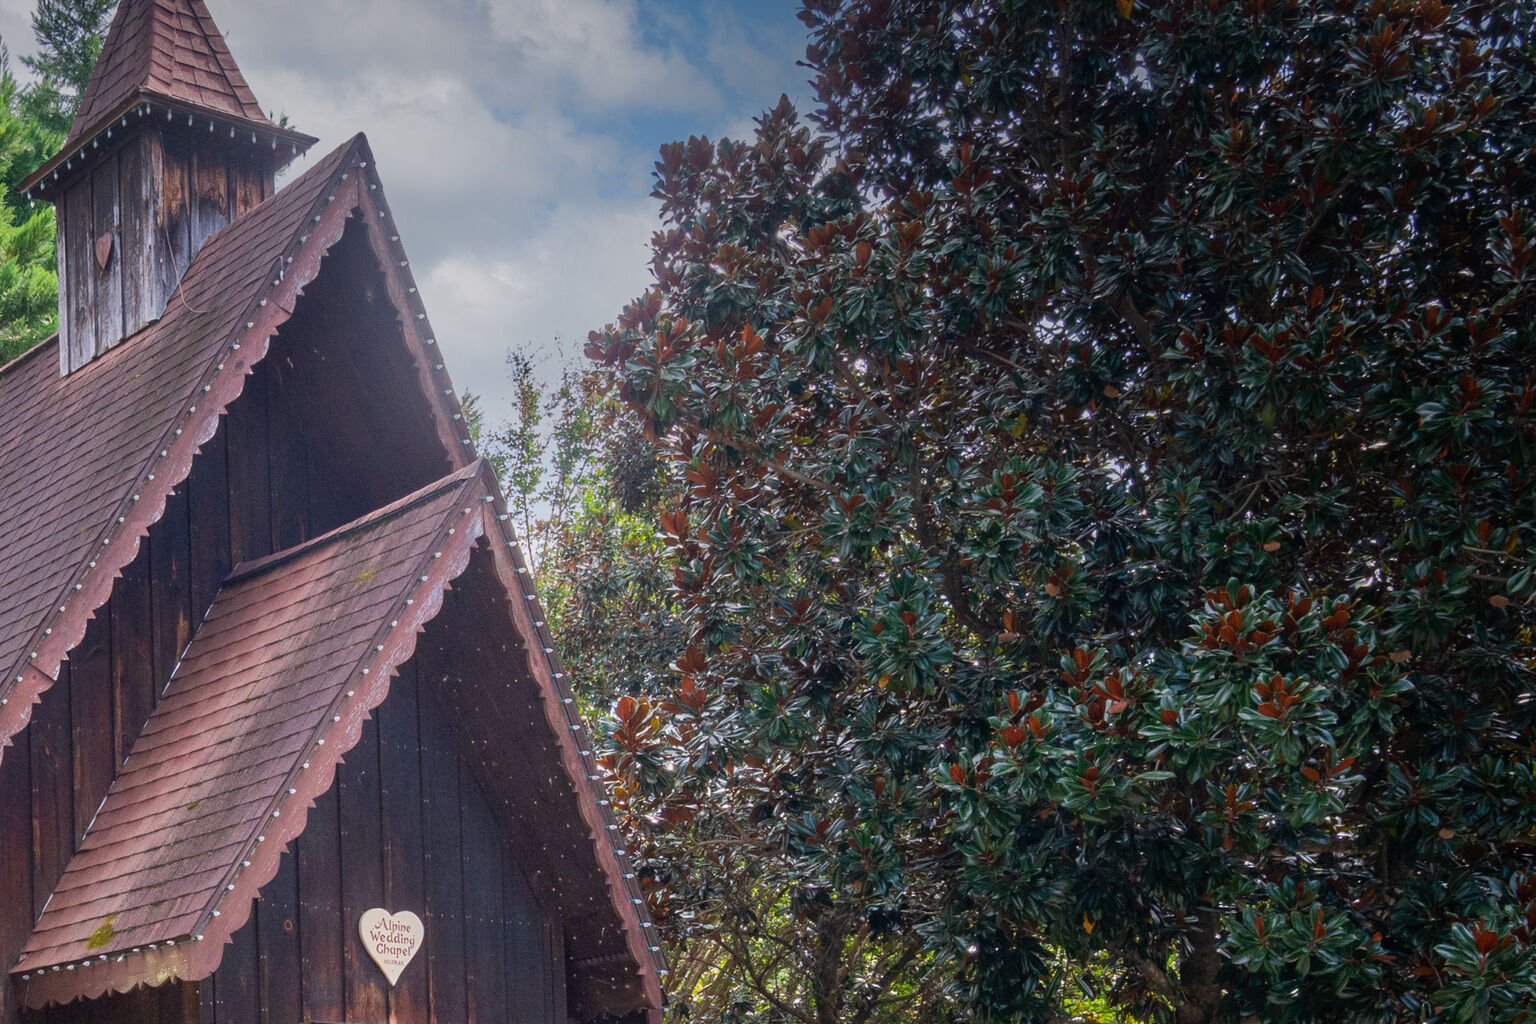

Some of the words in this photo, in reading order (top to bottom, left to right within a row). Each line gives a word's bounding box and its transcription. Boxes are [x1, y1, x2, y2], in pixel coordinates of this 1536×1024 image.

[374, 917, 412, 933] Alpine
[369, 930, 416, 949] Wedding
[376, 943, 412, 958] Chapel
